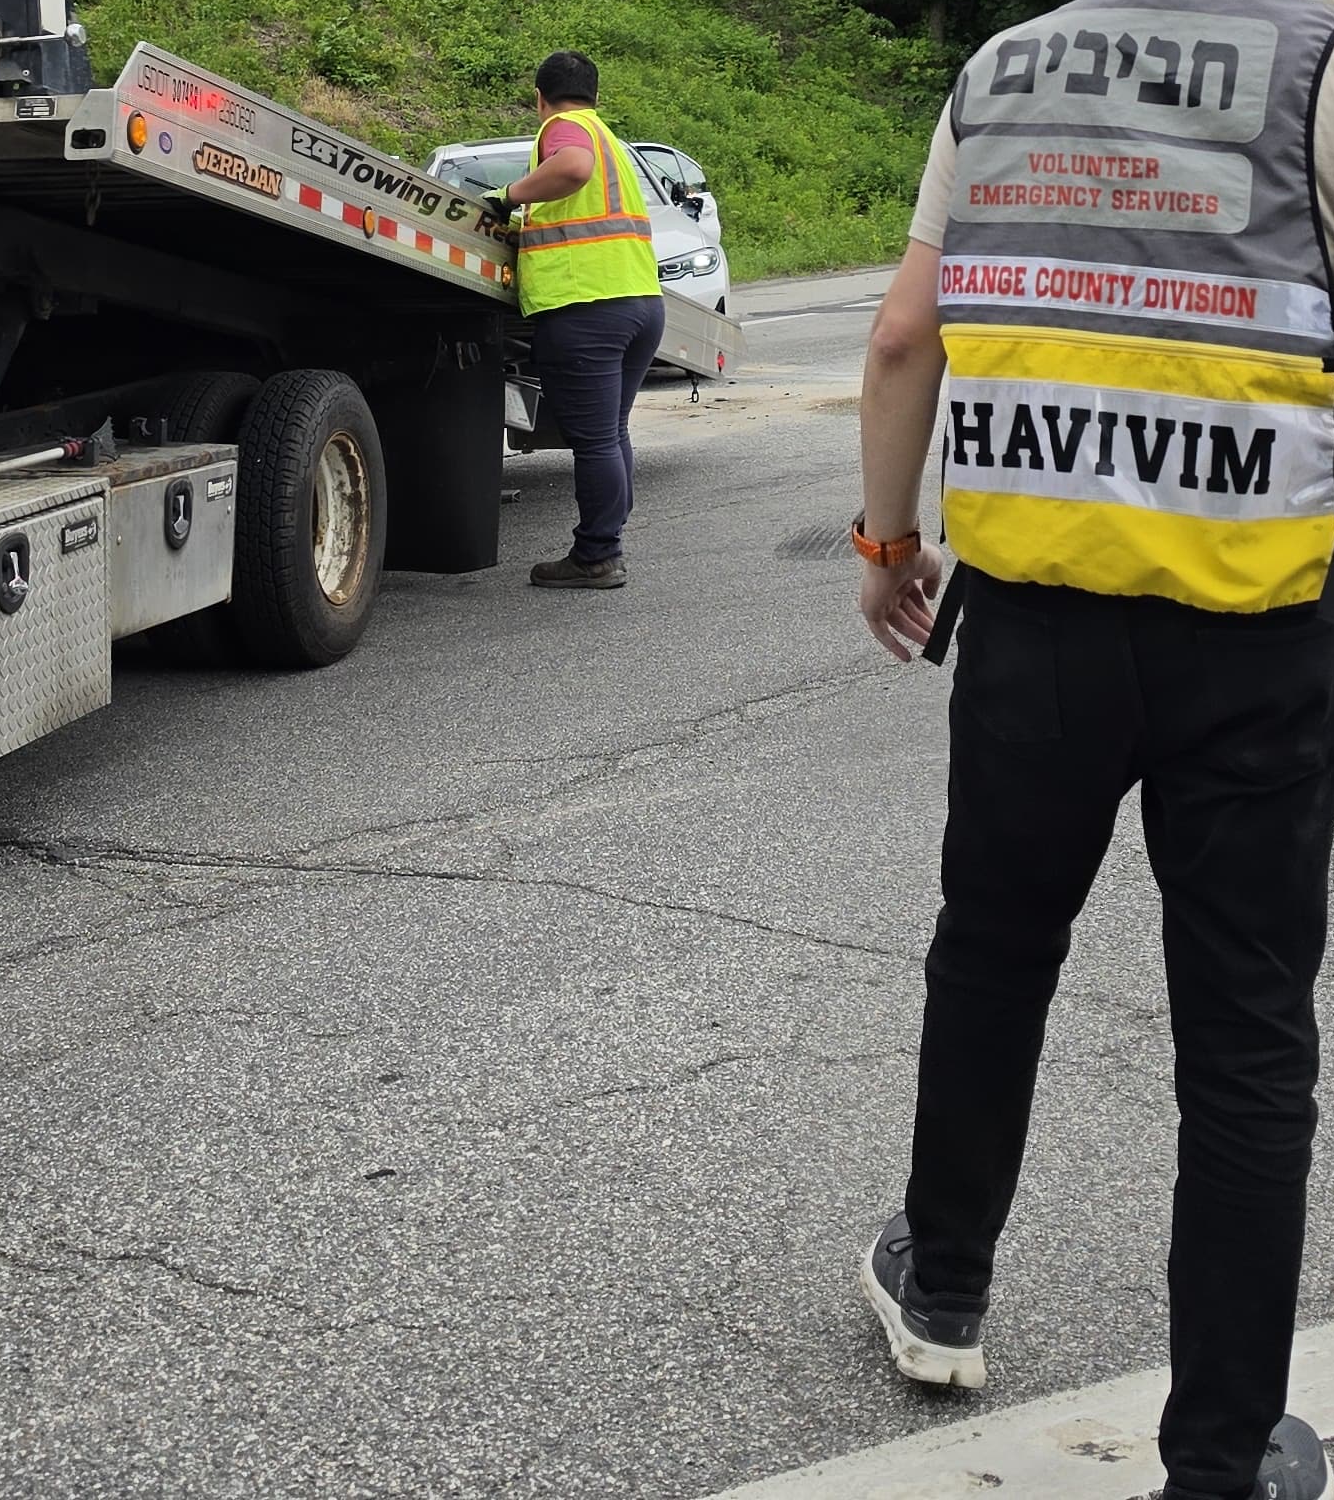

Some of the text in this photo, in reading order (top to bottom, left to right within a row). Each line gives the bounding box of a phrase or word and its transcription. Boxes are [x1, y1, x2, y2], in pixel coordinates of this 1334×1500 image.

[989, 29, 1240, 111] חביבים
[339, 148, 443, 217] Towing
[444, 197, 469, 222] &
[1028, 152, 1160, 180] VOLUNTEER
[969, 184, 1219, 215] EMERGENCY SERVICES
[942, 264, 1258, 320] ORANGE COUNTY DIVISION
